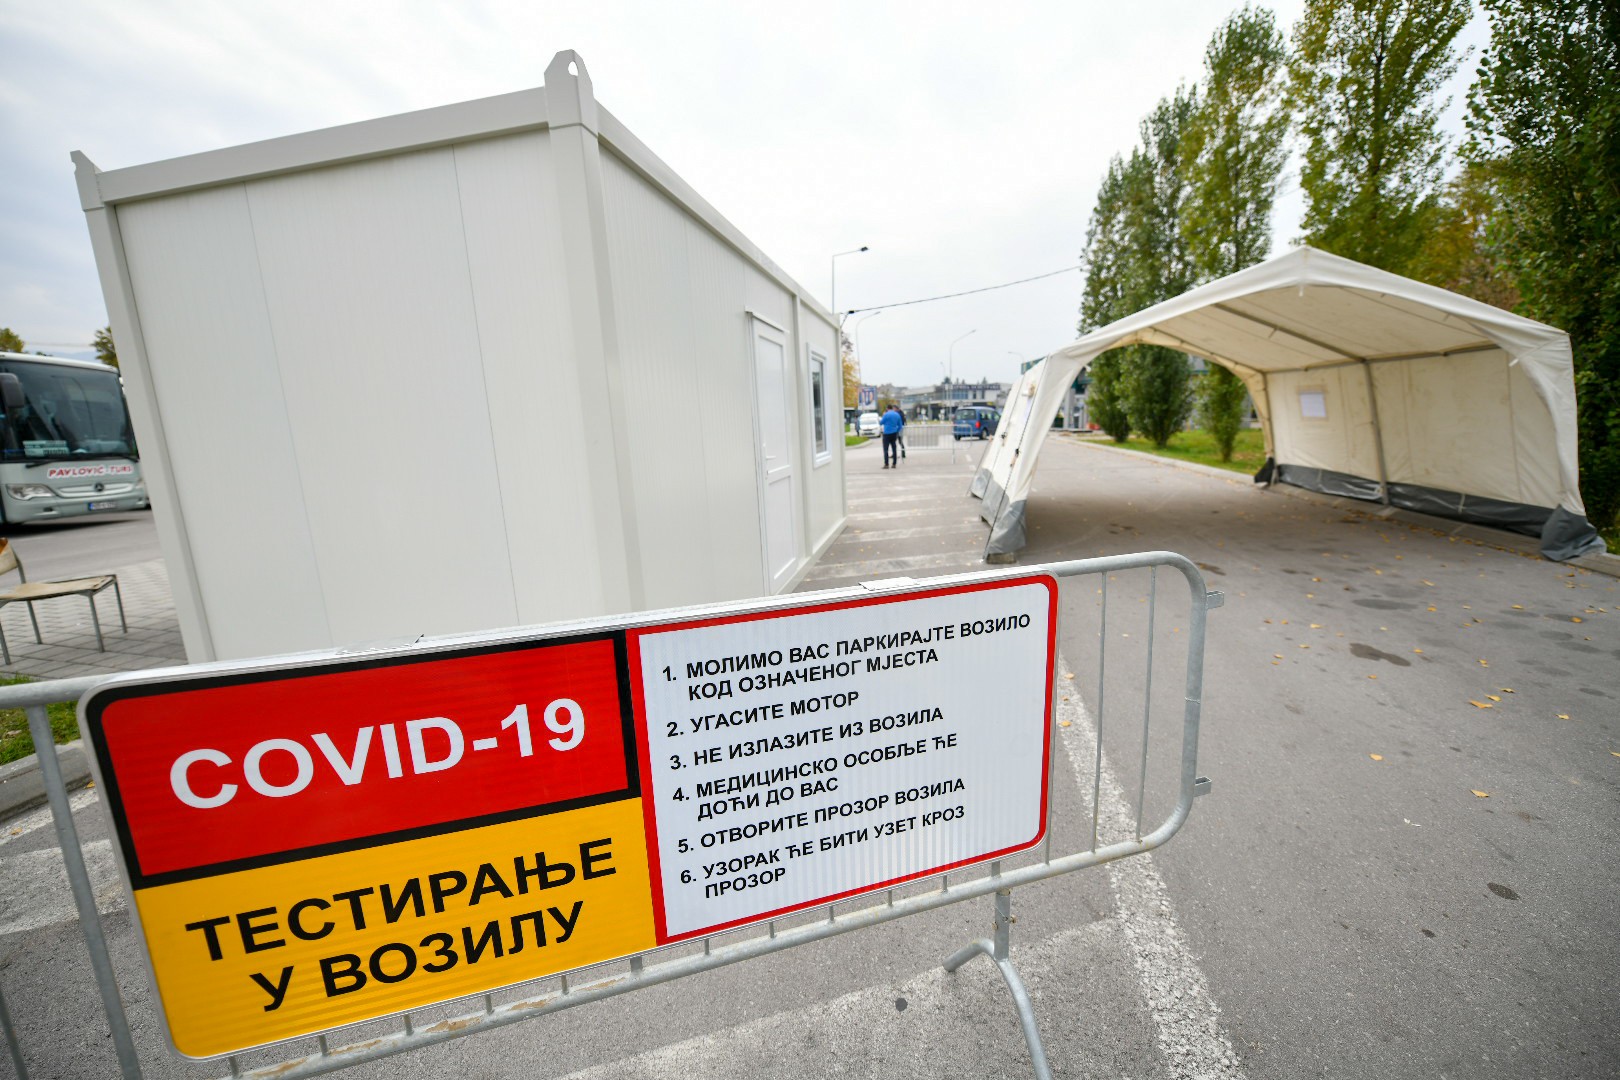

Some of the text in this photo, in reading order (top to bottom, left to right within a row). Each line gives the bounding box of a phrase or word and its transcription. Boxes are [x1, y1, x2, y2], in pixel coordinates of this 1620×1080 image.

[663, 614, 1030, 681] 1. МОЛИМО ВАС ПАРКИРАЈТЕ ВОЗИЛО
[689, 649, 938, 701] КОД ОЗНАЧЕНОГ МЈЕСТА
[667, 691, 858, 737] 2. УГАСИТЕ МОТОР
[670, 708, 943, 770] 3. НЕ ИЗЛАЗИТЕ ИЗ ВОЗИЛА
[171, 699, 584, 808] COVID-19
[673, 733, 957, 801] 4. МЕДИЦИНСКО ОСОБЉЕ ЋЕ
[679, 779, 965, 853] 5. ОТВОРИТЕ ПРОЗОР ВОЗИЛА
[698, 778, 838, 821] ДОЋИ ДО ВАС
[681, 806, 964, 883] 6. УЗОРАК ЋЕ БИТИ УЗЕТ КРОЗ
[185, 838, 616, 960] ТЕСТИРАЊЕ
[706, 868, 785, 898] ПРОЗОР
[249, 901, 583, 1012] У ВОЗИЛУ
